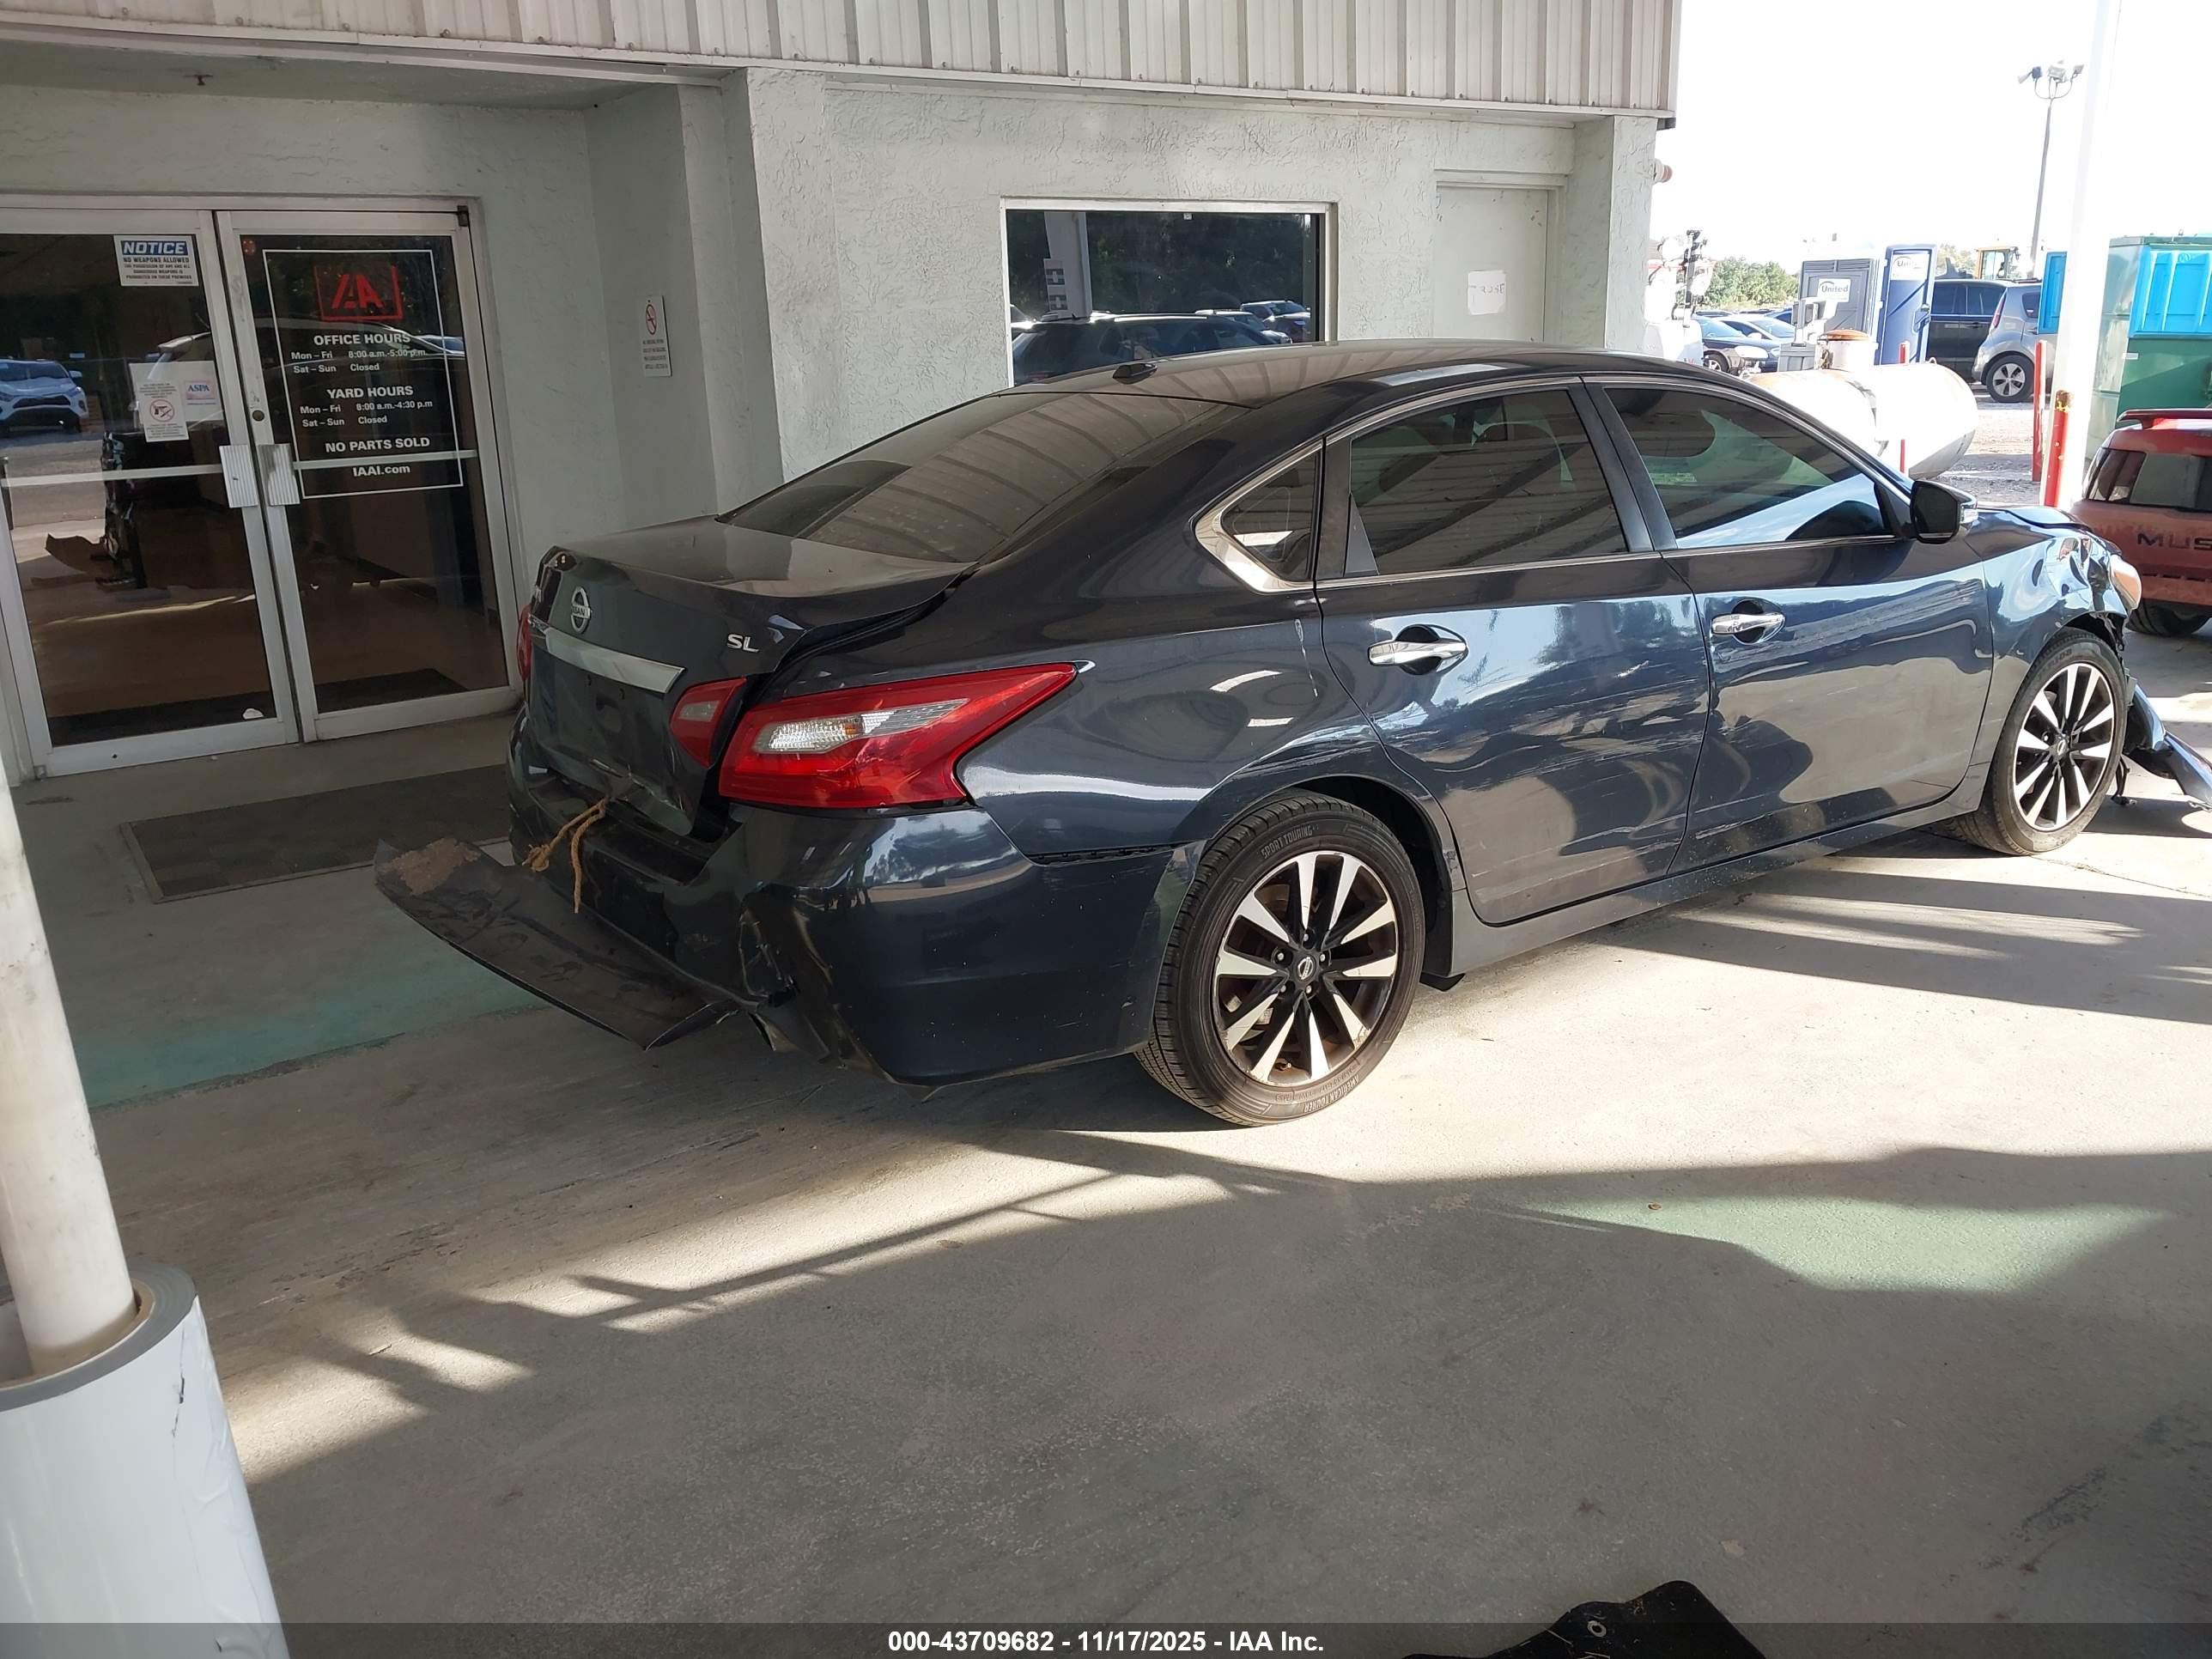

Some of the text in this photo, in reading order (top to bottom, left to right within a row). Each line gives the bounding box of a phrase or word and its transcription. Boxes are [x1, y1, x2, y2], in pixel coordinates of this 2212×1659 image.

[123, 241, 186, 254] NOTICE
[1821, 284, 1849, 293] United
[313, 332, 411, 346] OFFICE HOURS
[290, 351, 313, 360] Mon
[321, 350, 333, 359] Fri
[348, 350, 367, 359] 8:00
[349, 362, 380, 372] Closed
[188, 384, 210, 392] ASPA
[326, 386, 414, 399] YARD HOURS
[300, 405, 321, 414] Mon
[330, 404, 342, 413] Fri
[356, 403, 375, 411] 8:00
[301, 419, 319, 428] Sat
[326, 417, 345, 426] Sun
[357, 416, 388, 425] Closed
[325, 437, 430, 453] NO PARTS SOLD
[352, 465, 411, 477] IAAI.com
[726, 633, 760, 653] SL
[1260, 824, 1313, 860] SPORT TOURING
[1329, 1074, 1359, 1103] AMERICAN
[1304, 1095, 1329, 1113] TOURER
